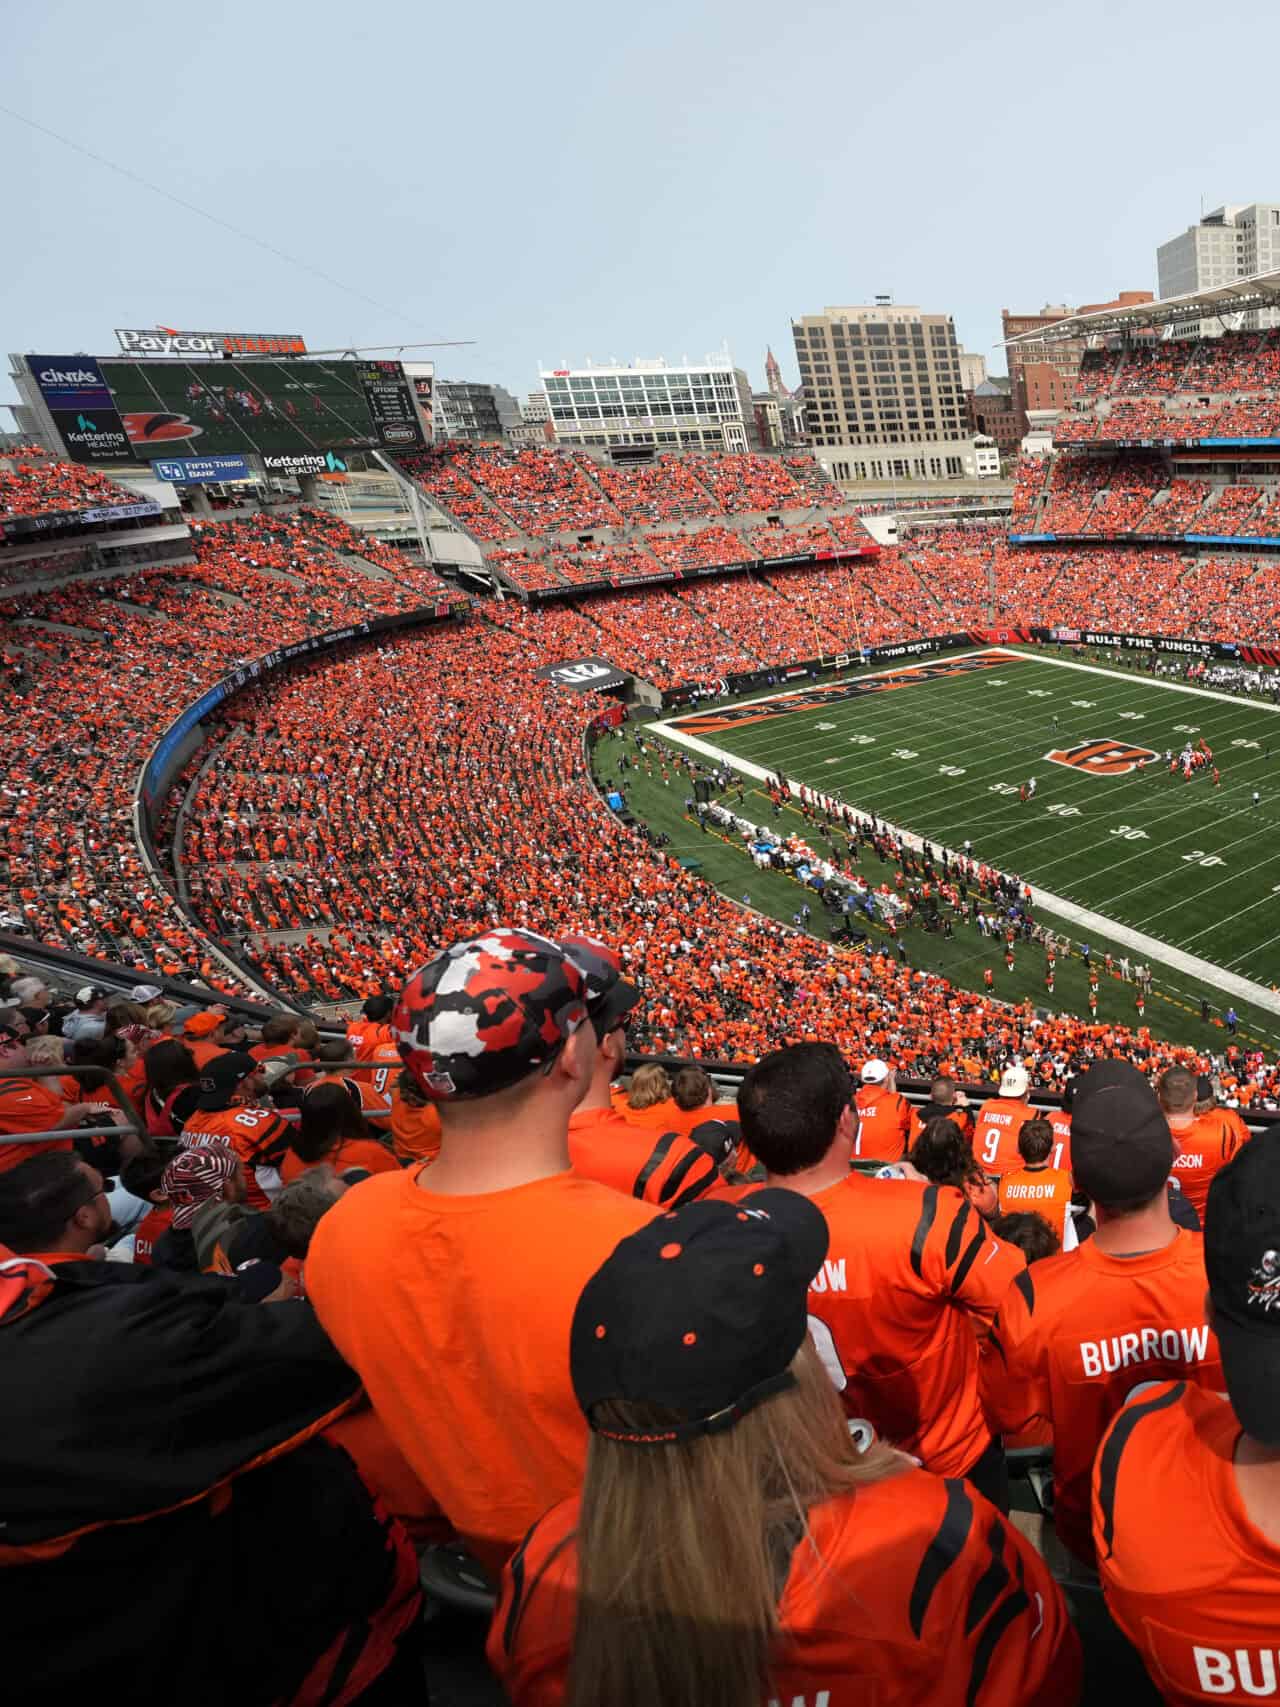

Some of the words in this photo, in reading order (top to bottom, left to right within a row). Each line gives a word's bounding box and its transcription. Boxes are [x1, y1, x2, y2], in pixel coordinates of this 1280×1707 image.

[119, 330, 219, 352] Paycor
[67, 432, 124, 442] Kettering
[186, 462, 213, 470] FIFTH
[264, 455, 325, 468] Kettering
[189, 470, 216, 478] BANK
[284, 467, 320, 475] HEALTH
[1086, 634, 1122, 645] RULE
[1126, 637, 1154, 649] THE
[1157, 640, 1212, 655] JUNGLE
[988, 782, 1020, 795] 50
[1182, 850, 1222, 867] 20
[235, 1108, 270, 1127] 85
[857, 1106, 877, 1118] ASE
[983, 1111, 1013, 1127] BURROW
[981, 1127, 1001, 1163] 9
[1053, 1142, 1064, 1171] 1
[1006, 1183, 1056, 1199] BURROW
[807, 1258, 848, 1293] OW
[1079, 1324, 1209, 1377] BURROW
